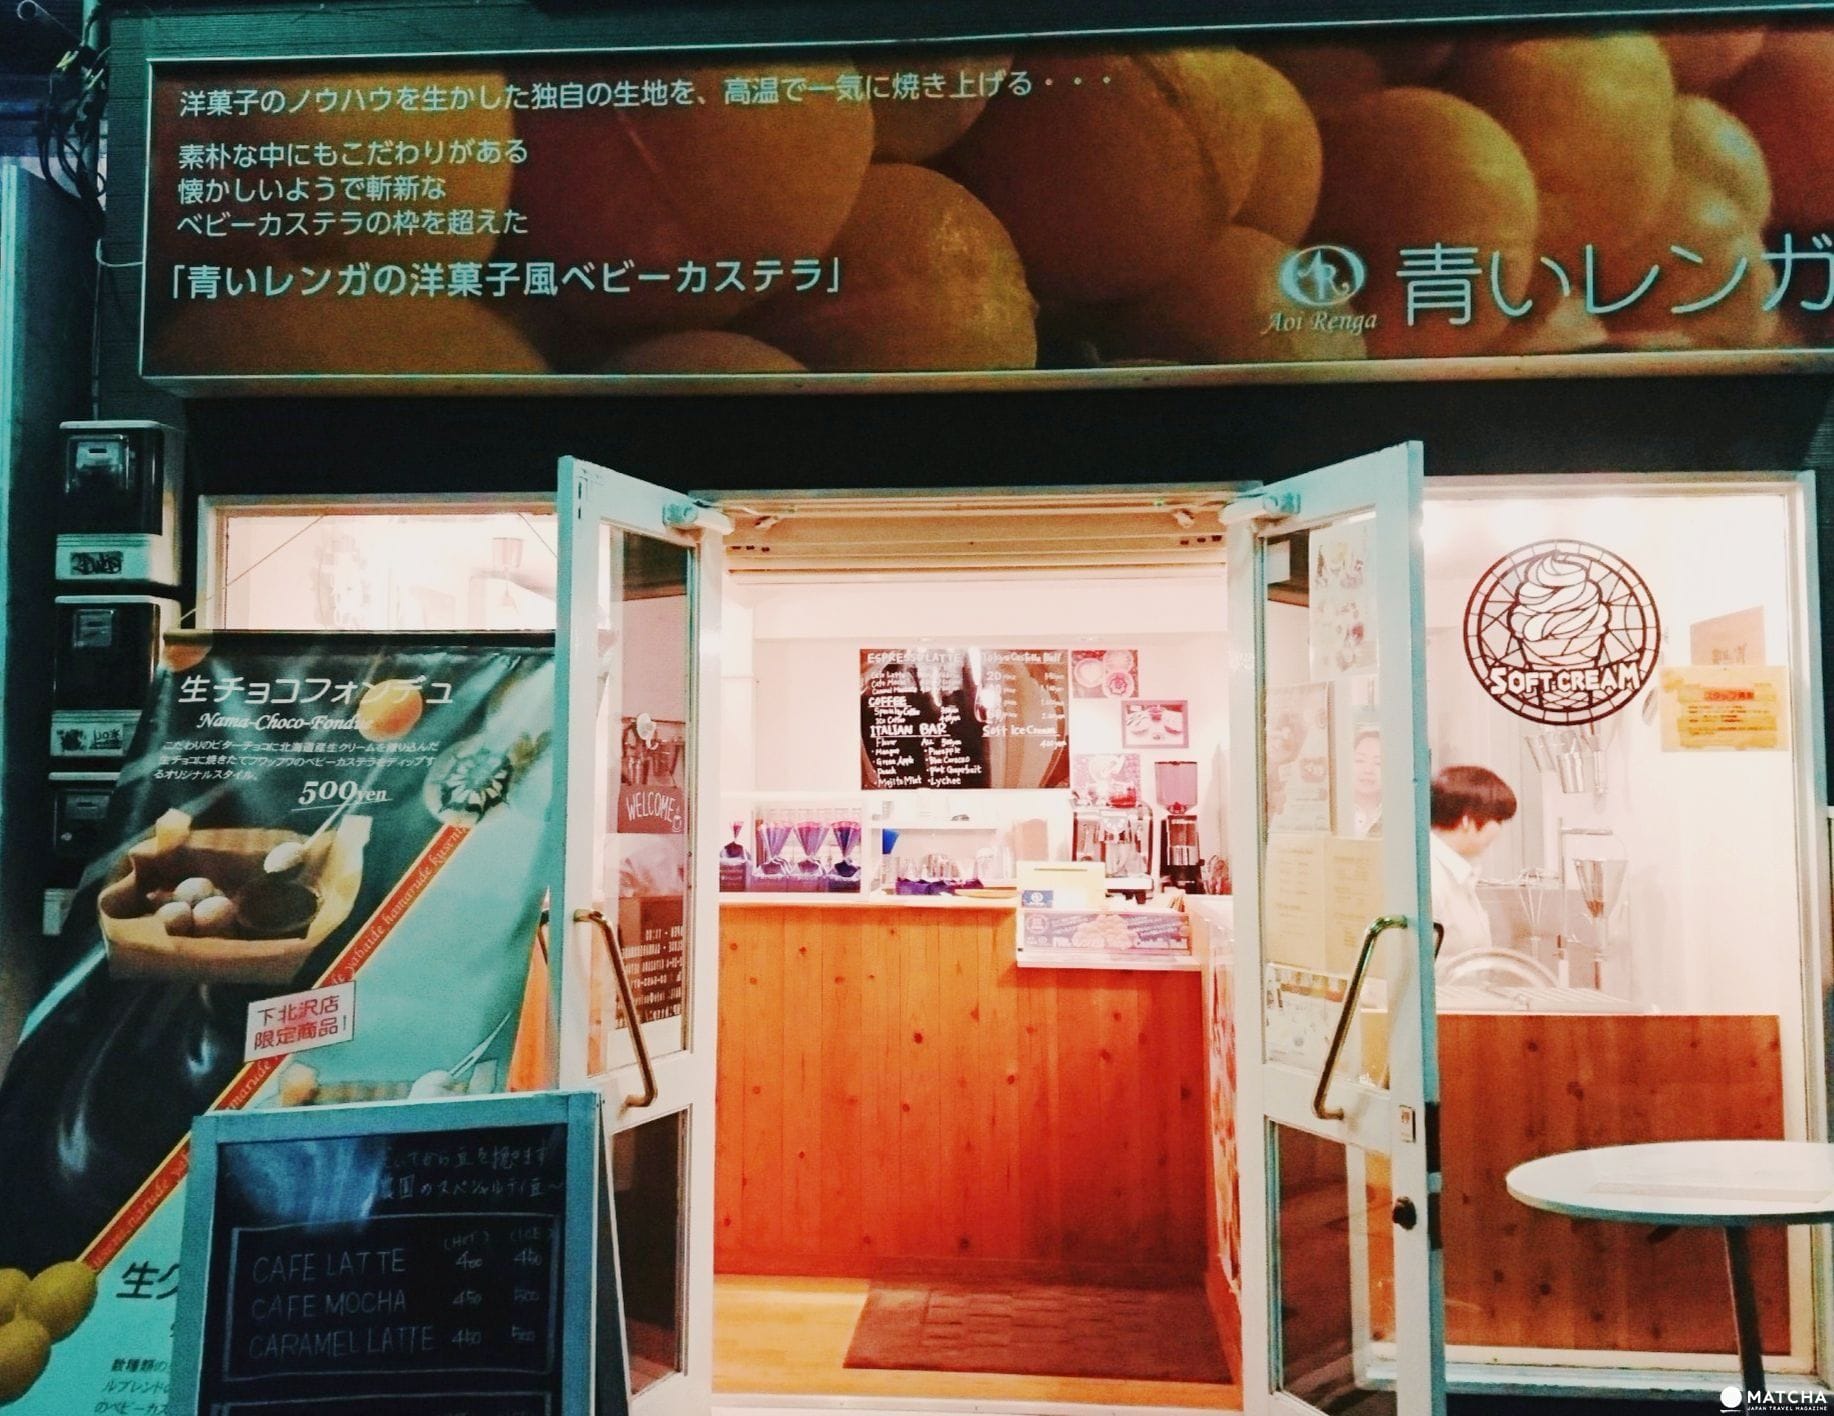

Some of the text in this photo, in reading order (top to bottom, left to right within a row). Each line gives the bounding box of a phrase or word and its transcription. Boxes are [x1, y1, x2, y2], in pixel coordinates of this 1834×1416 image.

[178, 140, 528, 171] 素朴な中にもこだわりがある
[178, 174, 447, 204] 懐かしいようで斬新な
[177, 209, 528, 238] ベビーカステラの枠を超えた
[172, 255, 840, 300] 「青いレンガの洋菓子風ベビーカステラ」
[1396, 233, 1834, 326] 青いレンガ
[1261, 311, 1378, 336] Aoi Renga
[178, 674, 454, 705] 生チョコフォンデュ
[1490, 662, 1641, 695] SOFT CREAM
[868, 696, 907, 706] COFFEE
[870, 723, 947, 735] ITALIAN BAR
[983, 725, 1008, 735] Soft
[299, 780, 358, 805] 500
[930, 776, 961, 787] Lychee
[626, 790, 675, 822] WELCOME
[257, 994, 340, 1027] 下北沢店
[252, 1253, 316, 1283] CAFE
[326, 1248, 406, 1276] LATTE
[251, 1293, 316, 1320] CAFE
[325, 1290, 407, 1317] MOCHA
[250, 1330, 359, 1360] CARAMEL
[367, 1326, 435, 1356] LATTE
